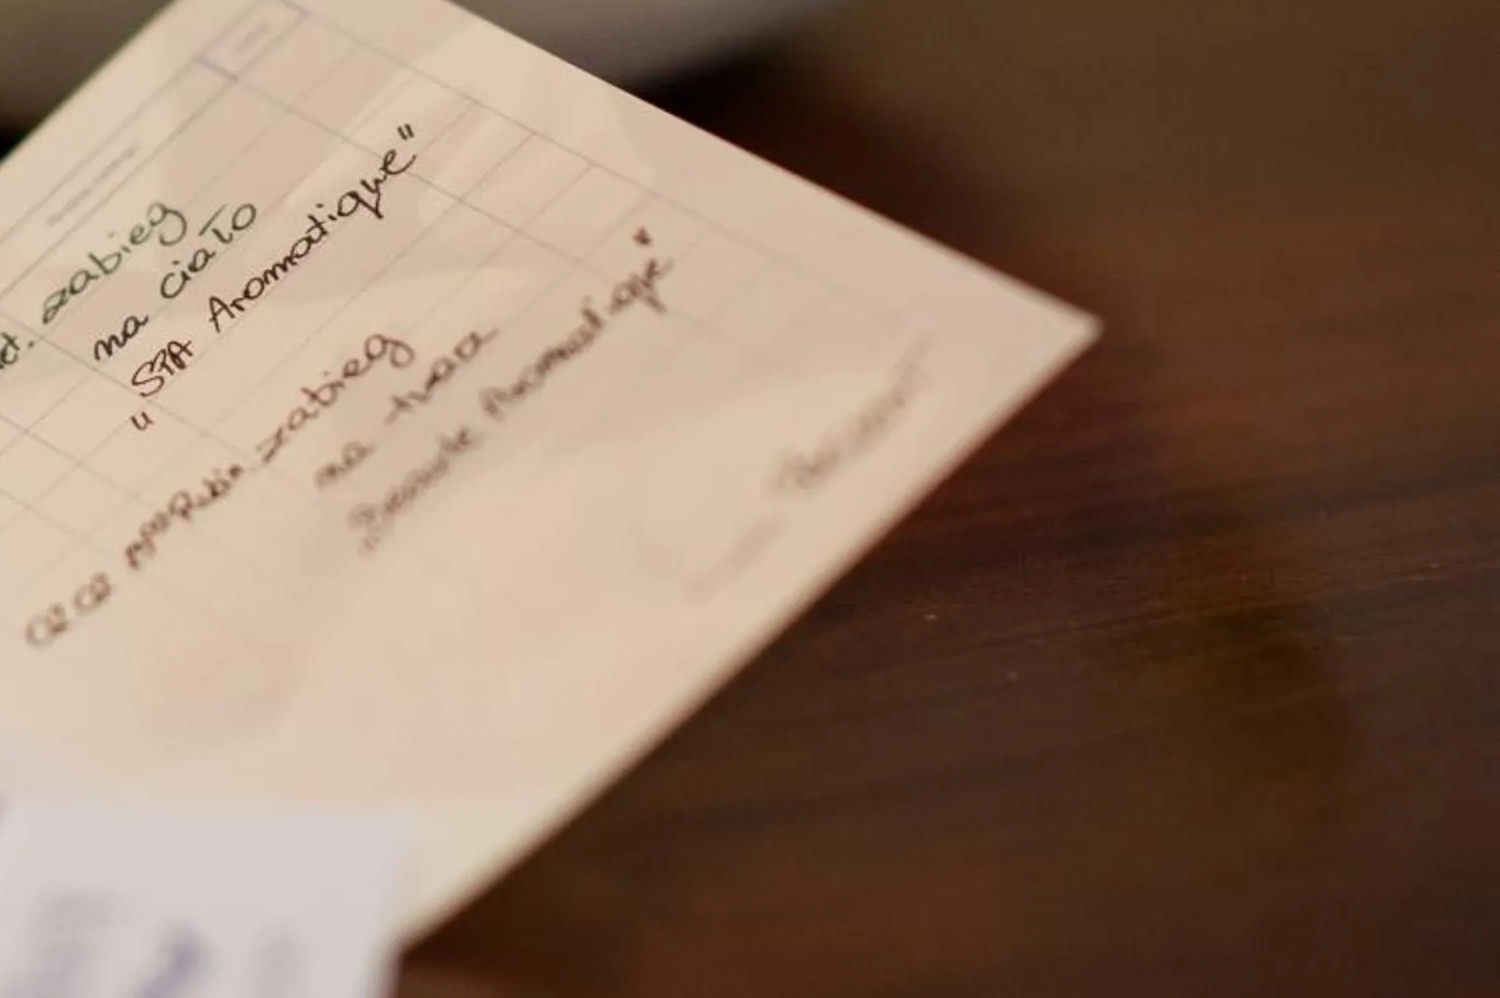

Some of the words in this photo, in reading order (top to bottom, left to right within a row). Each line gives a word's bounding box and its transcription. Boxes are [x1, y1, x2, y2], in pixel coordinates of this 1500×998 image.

[40, 200, 188, 326] zabieg
[93, 313, 149, 362] na
[255, 330, 415, 466] zabieg
[313, 440, 376, 490] na
